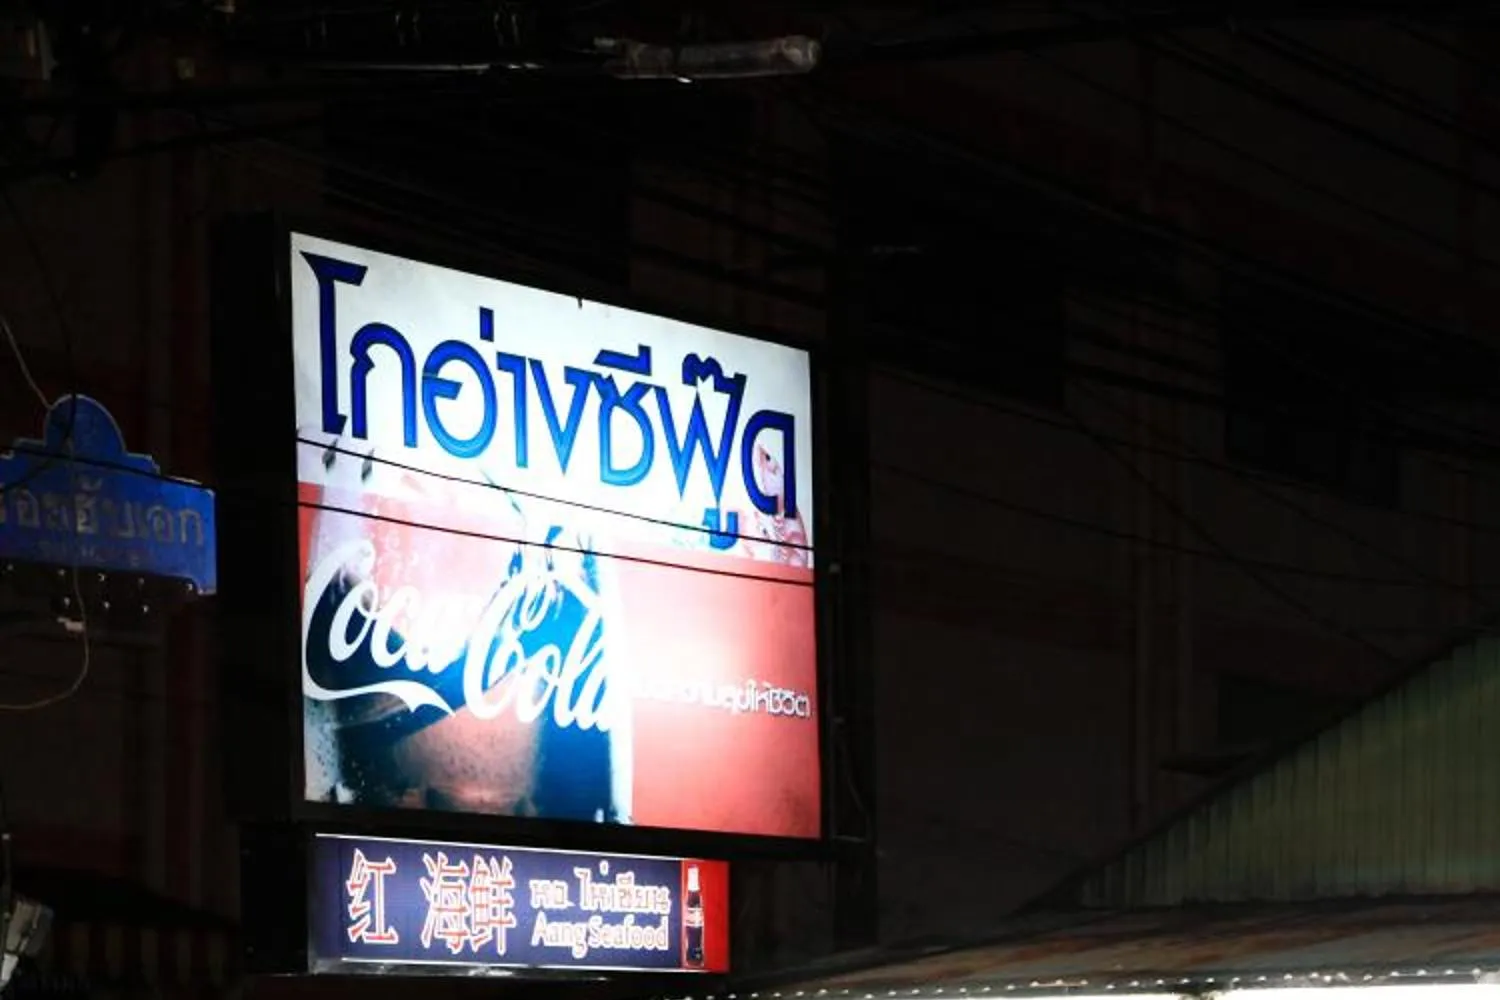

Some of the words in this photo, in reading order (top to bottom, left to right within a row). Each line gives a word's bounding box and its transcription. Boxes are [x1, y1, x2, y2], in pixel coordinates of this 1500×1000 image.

[346, 847, 399, 946] 红
[420, 851, 518, 956] 海鲜
[531, 911, 588, 959] Aang
[587, 914, 669, 950] Seafood
